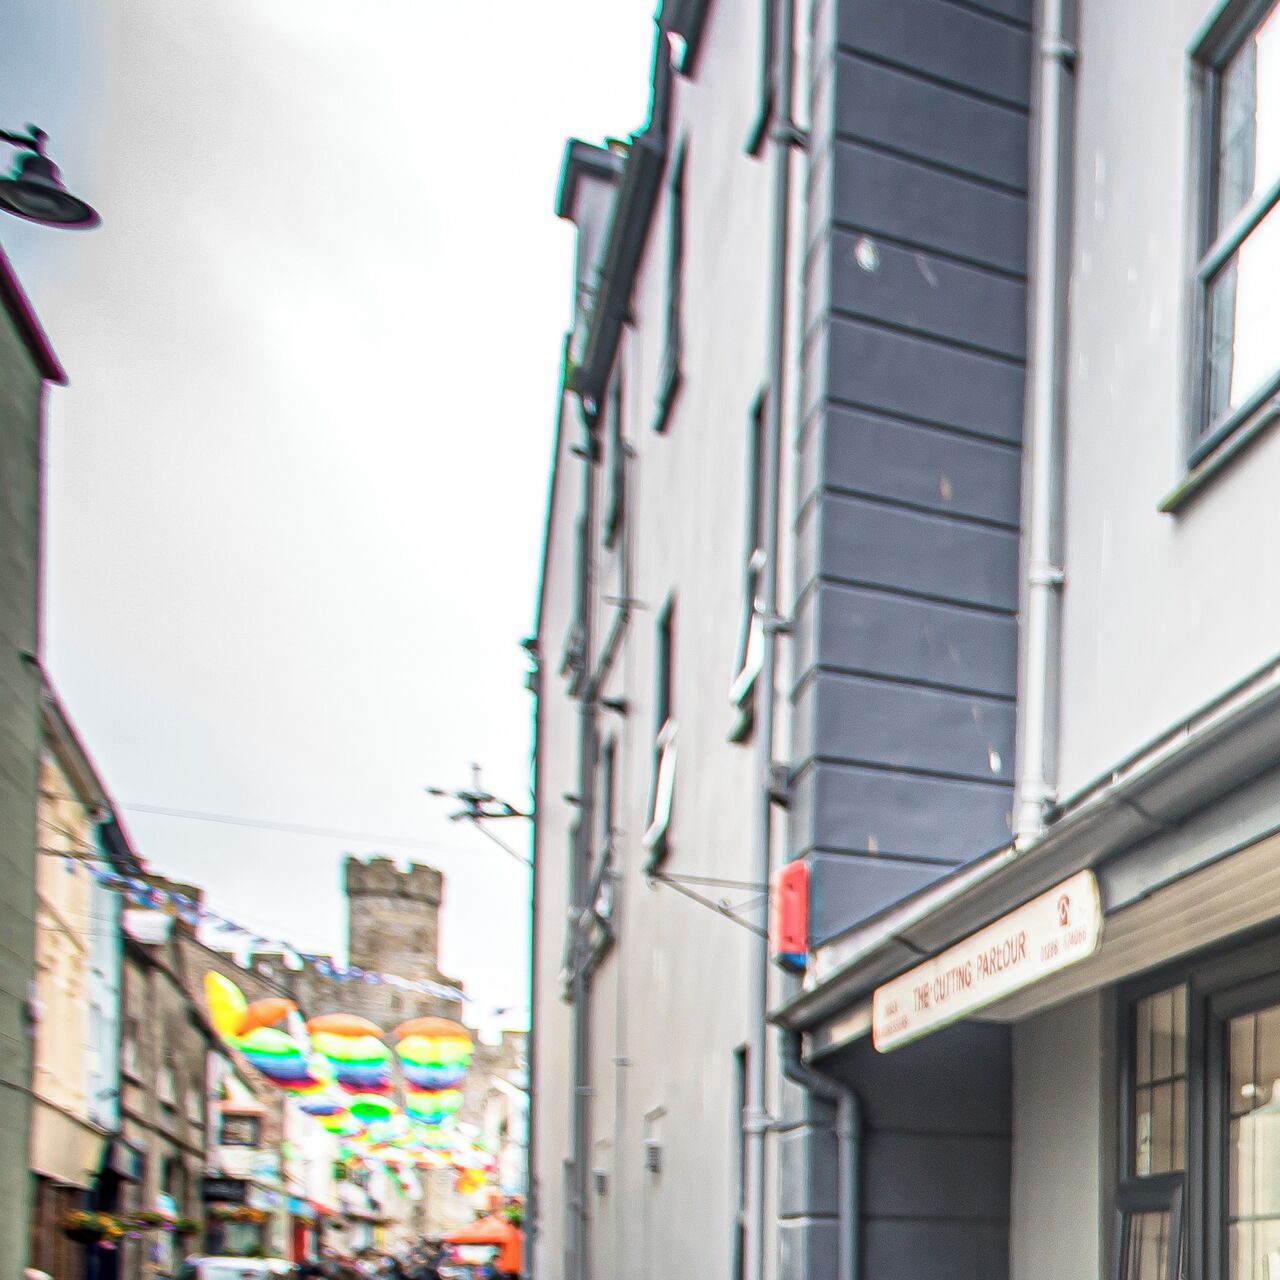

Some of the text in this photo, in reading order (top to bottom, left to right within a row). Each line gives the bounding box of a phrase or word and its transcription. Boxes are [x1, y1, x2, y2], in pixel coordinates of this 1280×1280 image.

[913, 931, 1026, 1012] THE CUTTING PARLOUR
